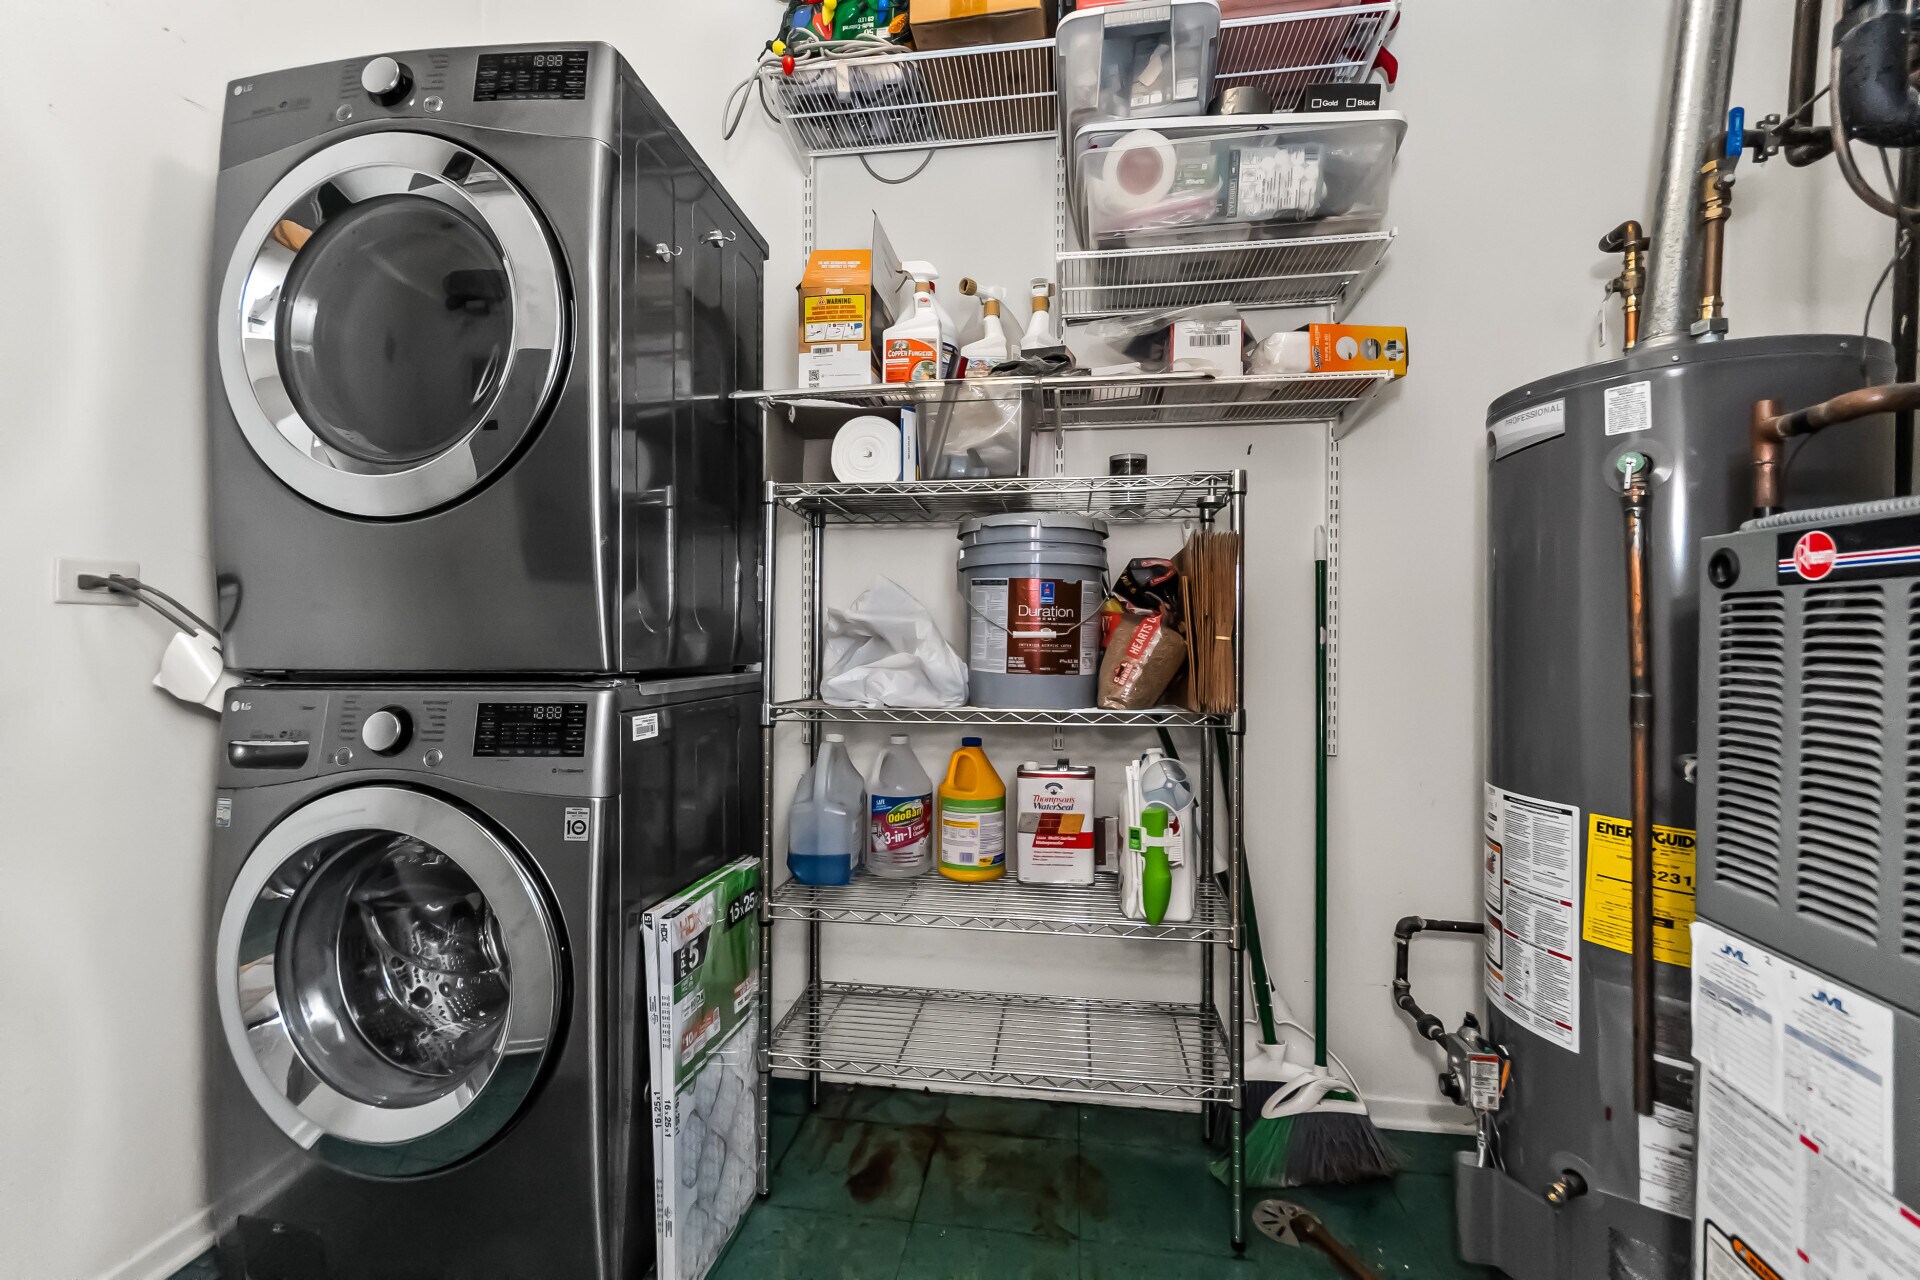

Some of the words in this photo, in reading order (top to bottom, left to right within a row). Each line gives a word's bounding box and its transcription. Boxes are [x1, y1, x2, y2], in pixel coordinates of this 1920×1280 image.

[1322, 99, 1339, 107] Gold
[888, 350, 907, 358] COPPER
[1505, 403, 1563, 426] PROFESSIONAL
[1018, 604, 1074, 618] Duration
[1129, 622, 1154, 655] HEARTS
[1033, 802, 1075, 811] WaterSeal
[888, 808, 922, 823] OdoBan
[566, 819, 587, 836] 10
[884, 826, 912, 845] 3-in-1
[660, 923, 669, 944] HDX
[689, 938, 700, 969] 5
